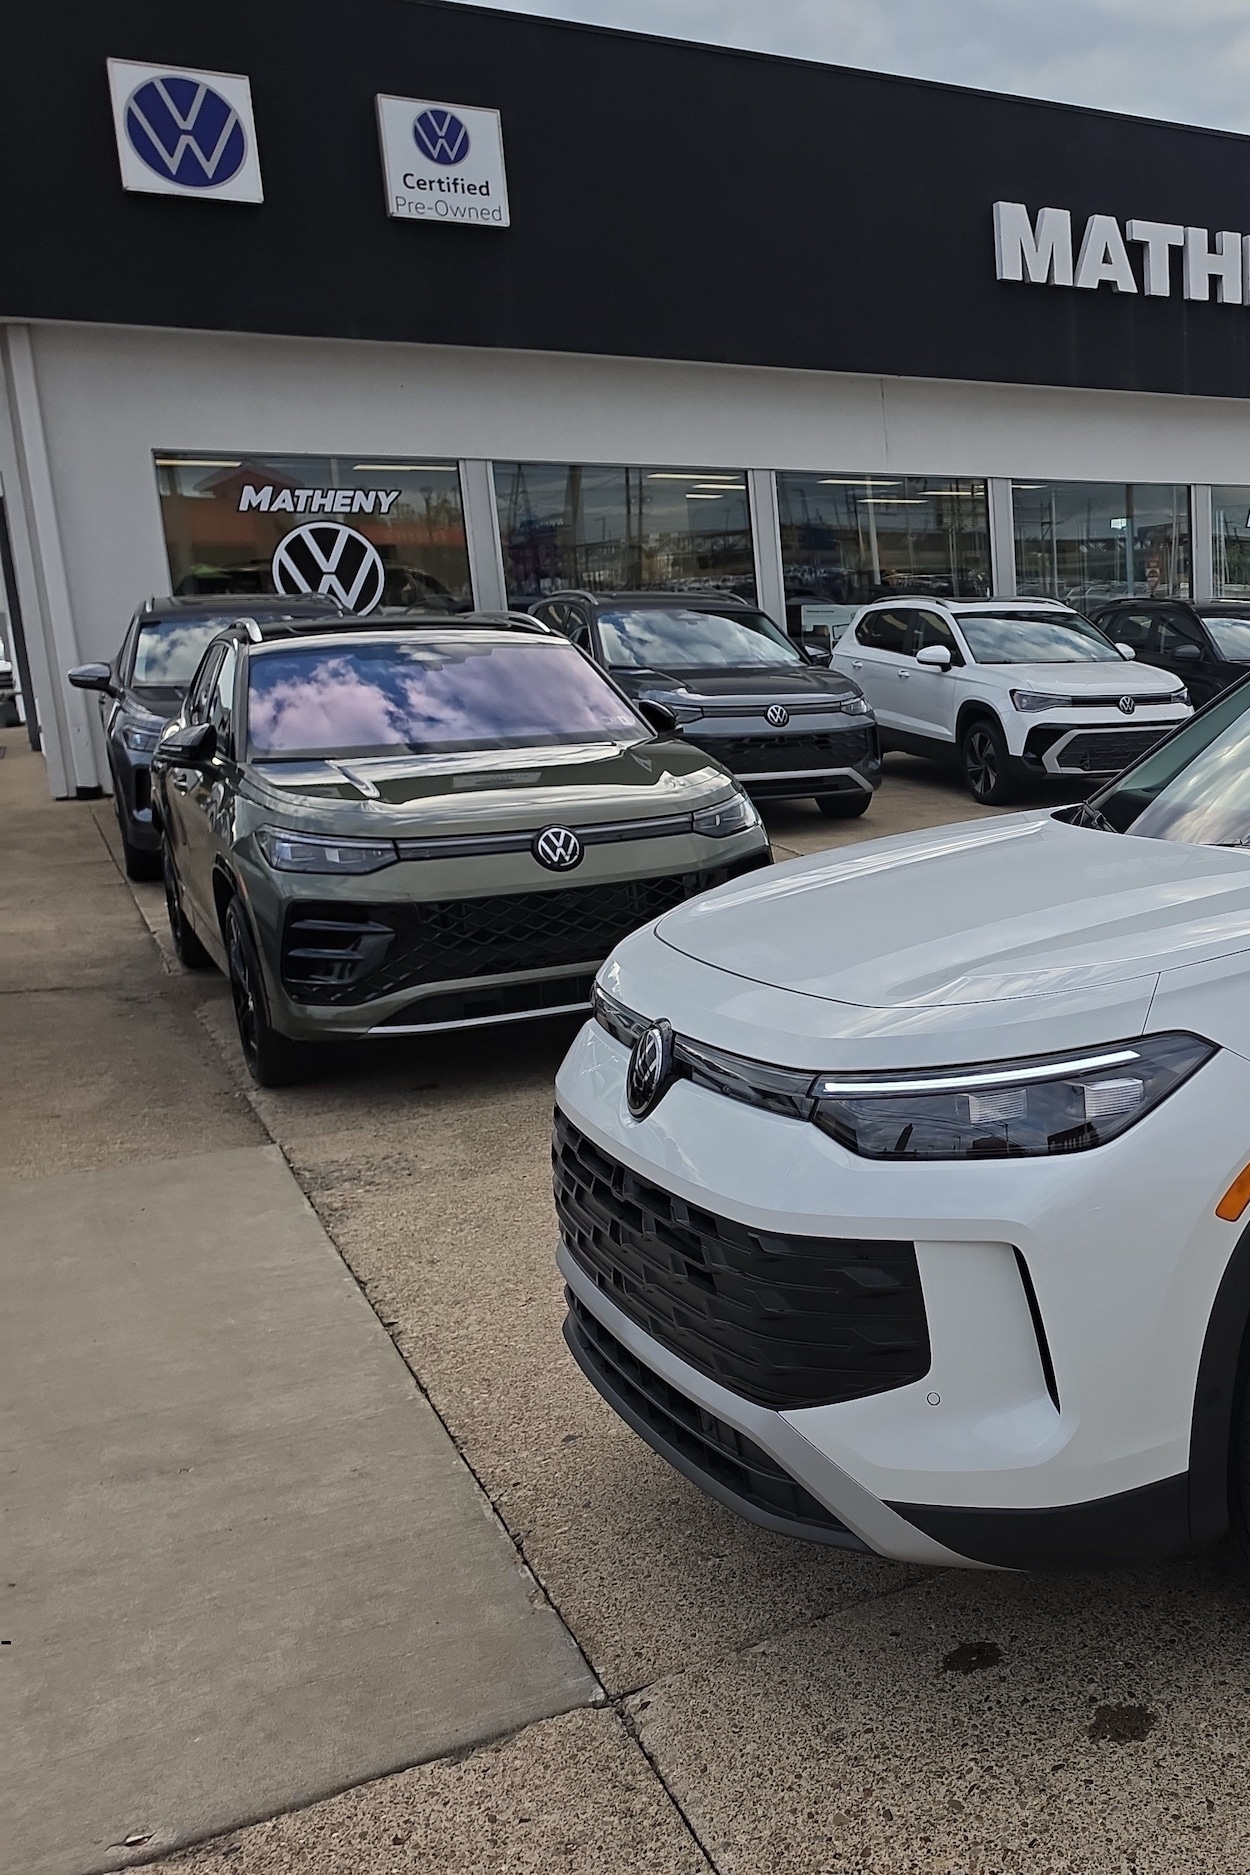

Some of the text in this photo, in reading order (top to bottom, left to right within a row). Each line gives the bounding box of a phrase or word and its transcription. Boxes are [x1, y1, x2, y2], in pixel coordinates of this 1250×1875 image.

[402, 173, 491, 197] Certified
[395, 196, 502, 222] Pre-Owned
[238, 484, 401, 514] MATHENY
